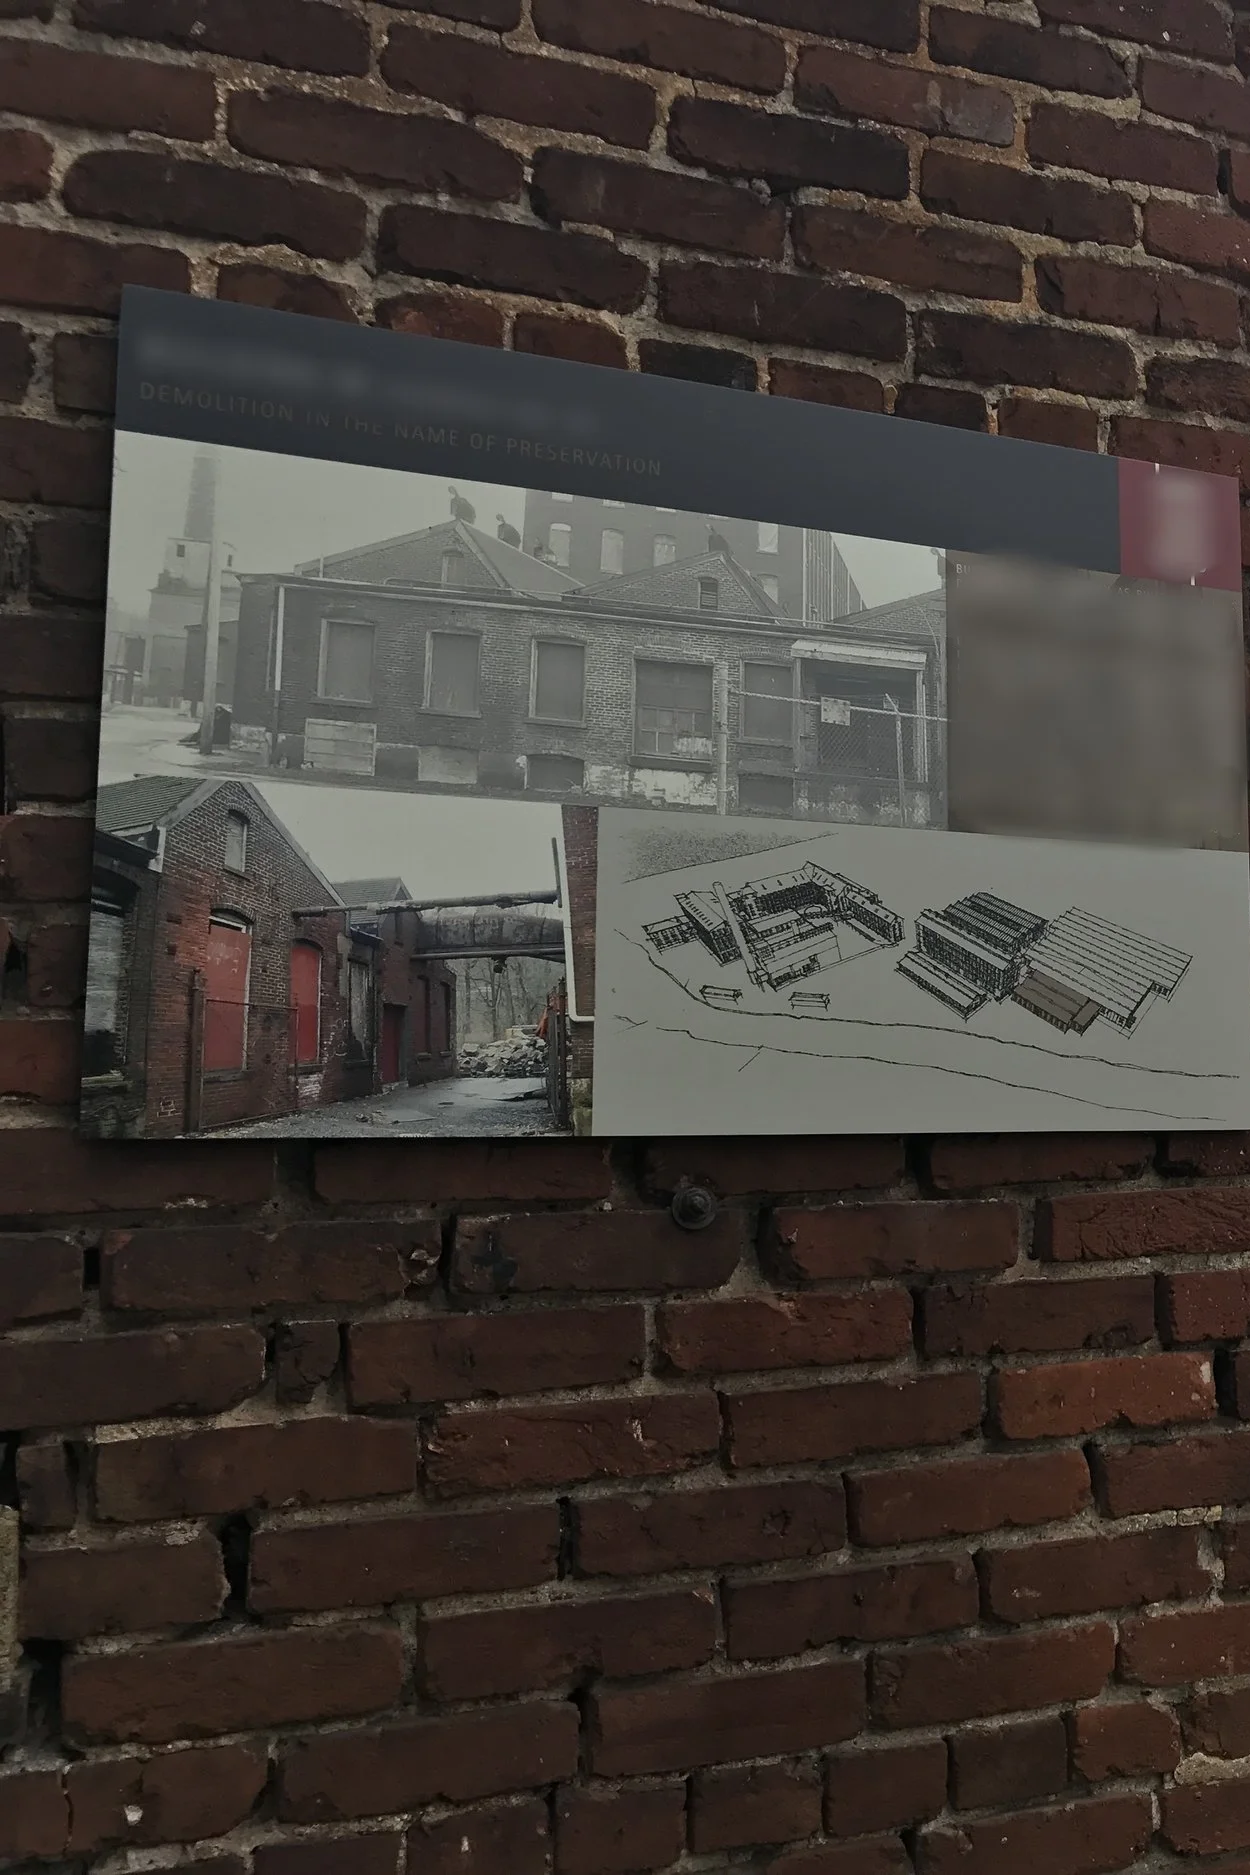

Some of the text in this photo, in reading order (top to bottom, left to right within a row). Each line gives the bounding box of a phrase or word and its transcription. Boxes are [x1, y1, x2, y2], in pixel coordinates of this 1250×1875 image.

[139, 381, 661, 476] DEMOLITION IN THE NAME OF PRESERVATION
